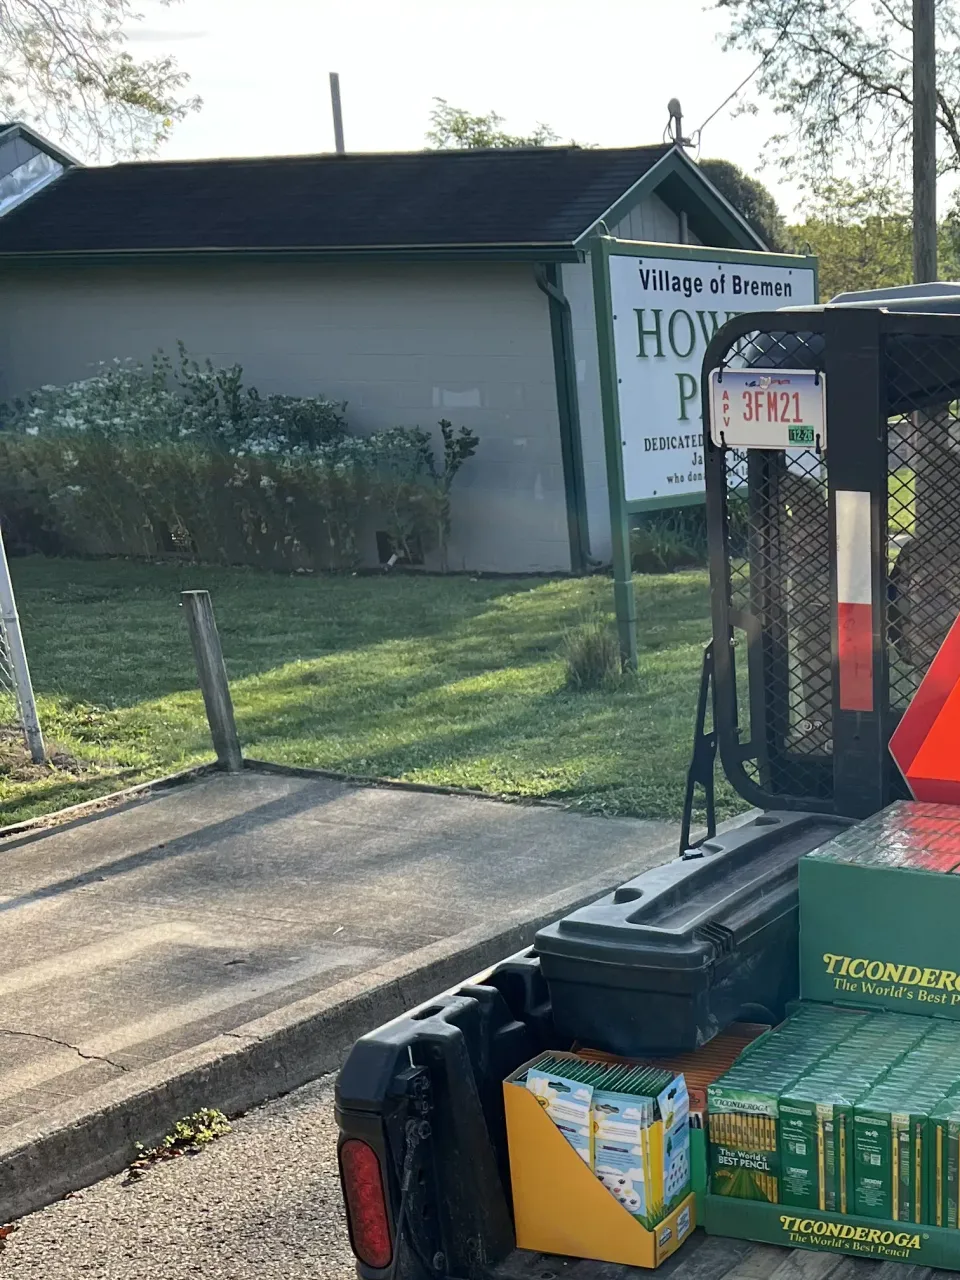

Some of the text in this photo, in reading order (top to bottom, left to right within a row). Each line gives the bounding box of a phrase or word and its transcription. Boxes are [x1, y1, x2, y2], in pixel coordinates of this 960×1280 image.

[639, 268, 792, 298] Village of Bremen
[742, 391, 803, 423] 3FM21
[667, 473, 684, 484] who
[833, 977, 857, 991] The
[861, 981, 913, 1000] World's
[918, 990, 948, 1004] Best
[714, 1098, 769, 1113] TICONDEROGA
[718, 1156, 770, 1171] BEST PENCIL
[720, 1148, 767, 1162] The World's
[780, 1215, 921, 1249] TICONDEROGA
[789, 1232, 910, 1258] The World's Best Pencil
